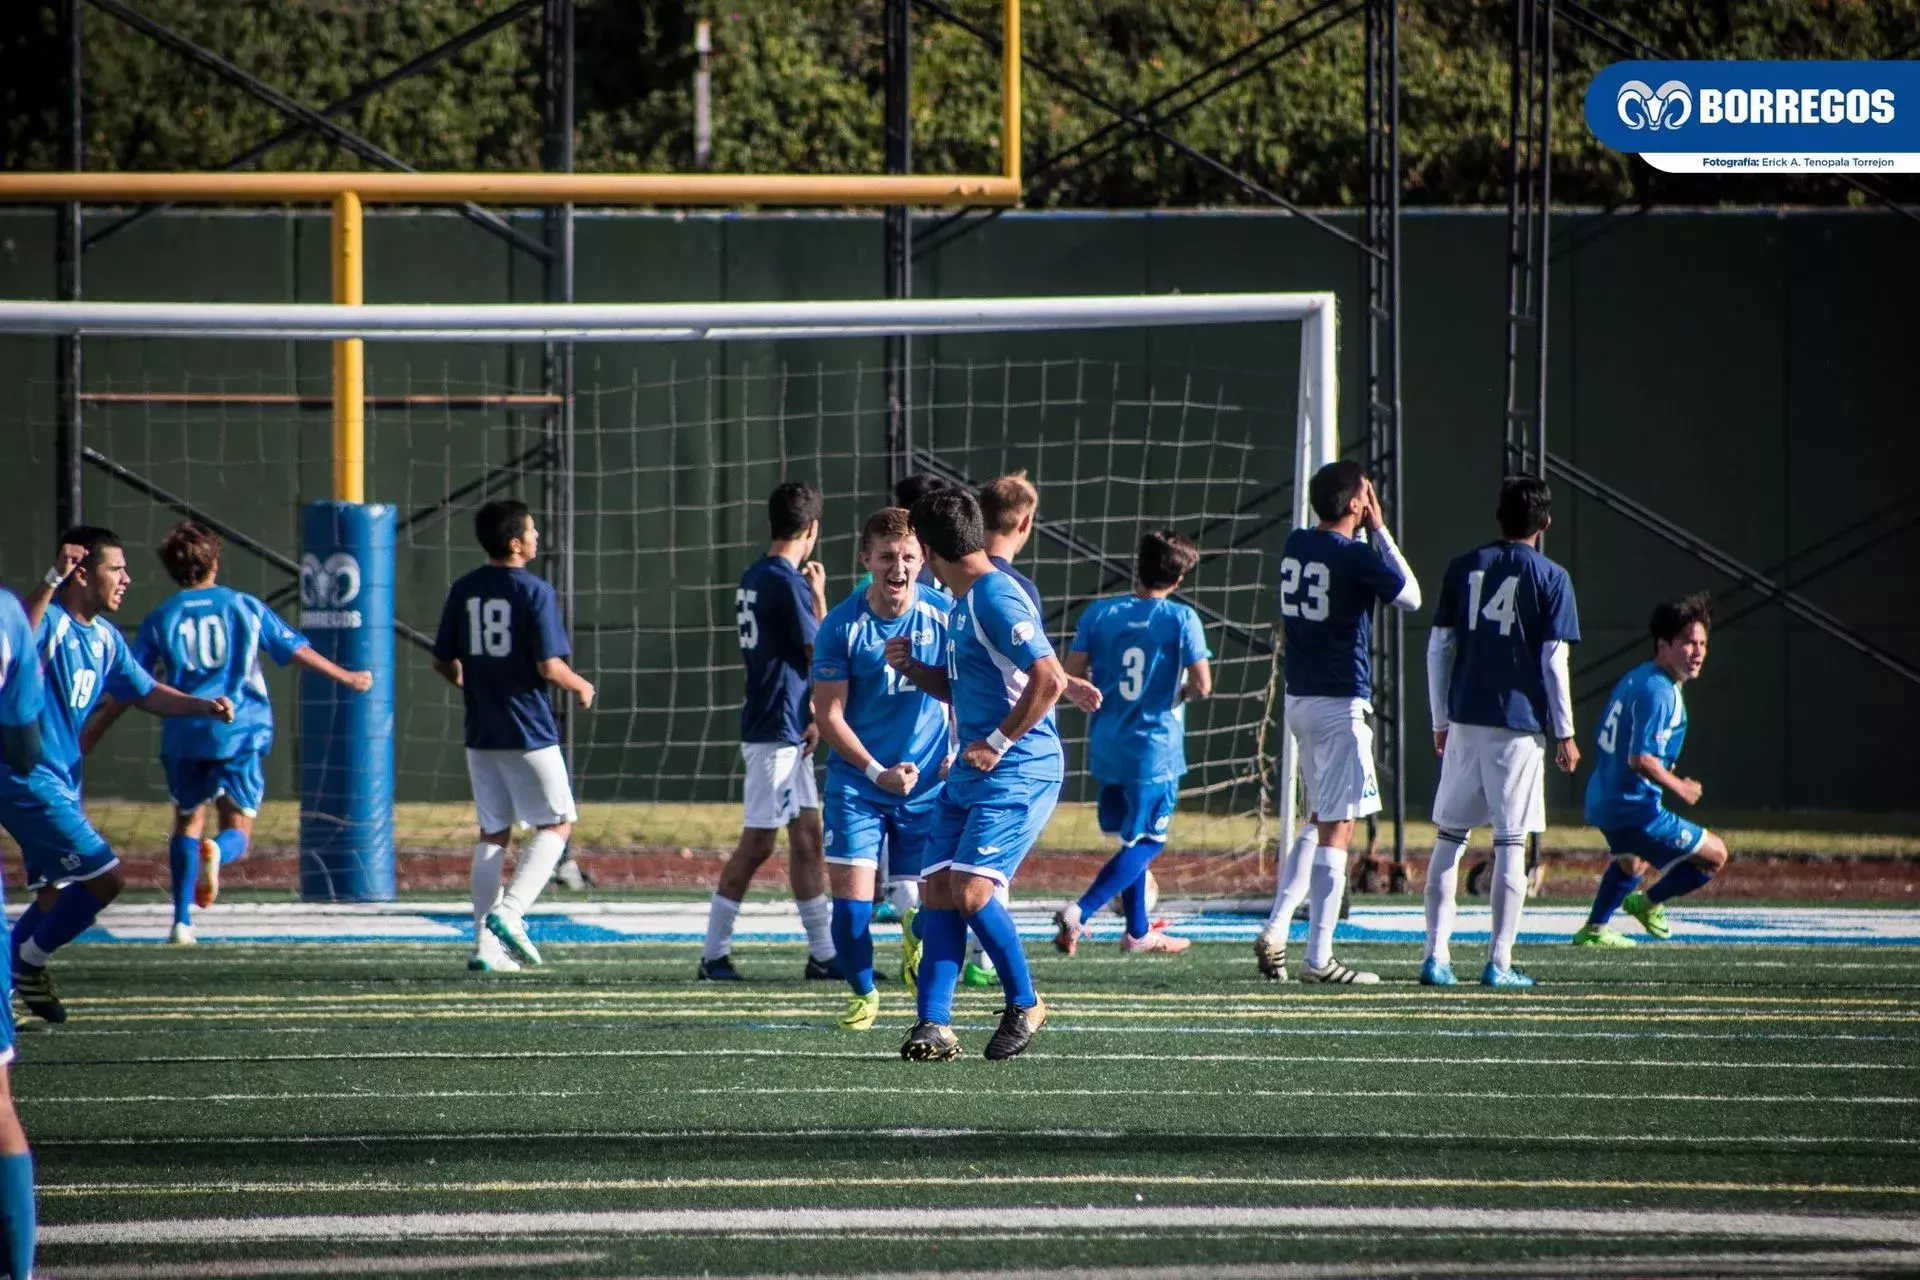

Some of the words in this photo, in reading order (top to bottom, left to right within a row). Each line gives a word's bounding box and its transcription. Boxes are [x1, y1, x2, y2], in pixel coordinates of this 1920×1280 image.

[1280, 556, 1330, 622] 23
[1467, 569, 1519, 636] 14
[179, 614, 227, 671] 10
[465, 596, 512, 657] 18
[70, 667, 96, 709] 19
[1119, 646, 1146, 701] 3
[1598, 699, 1623, 754] 5
